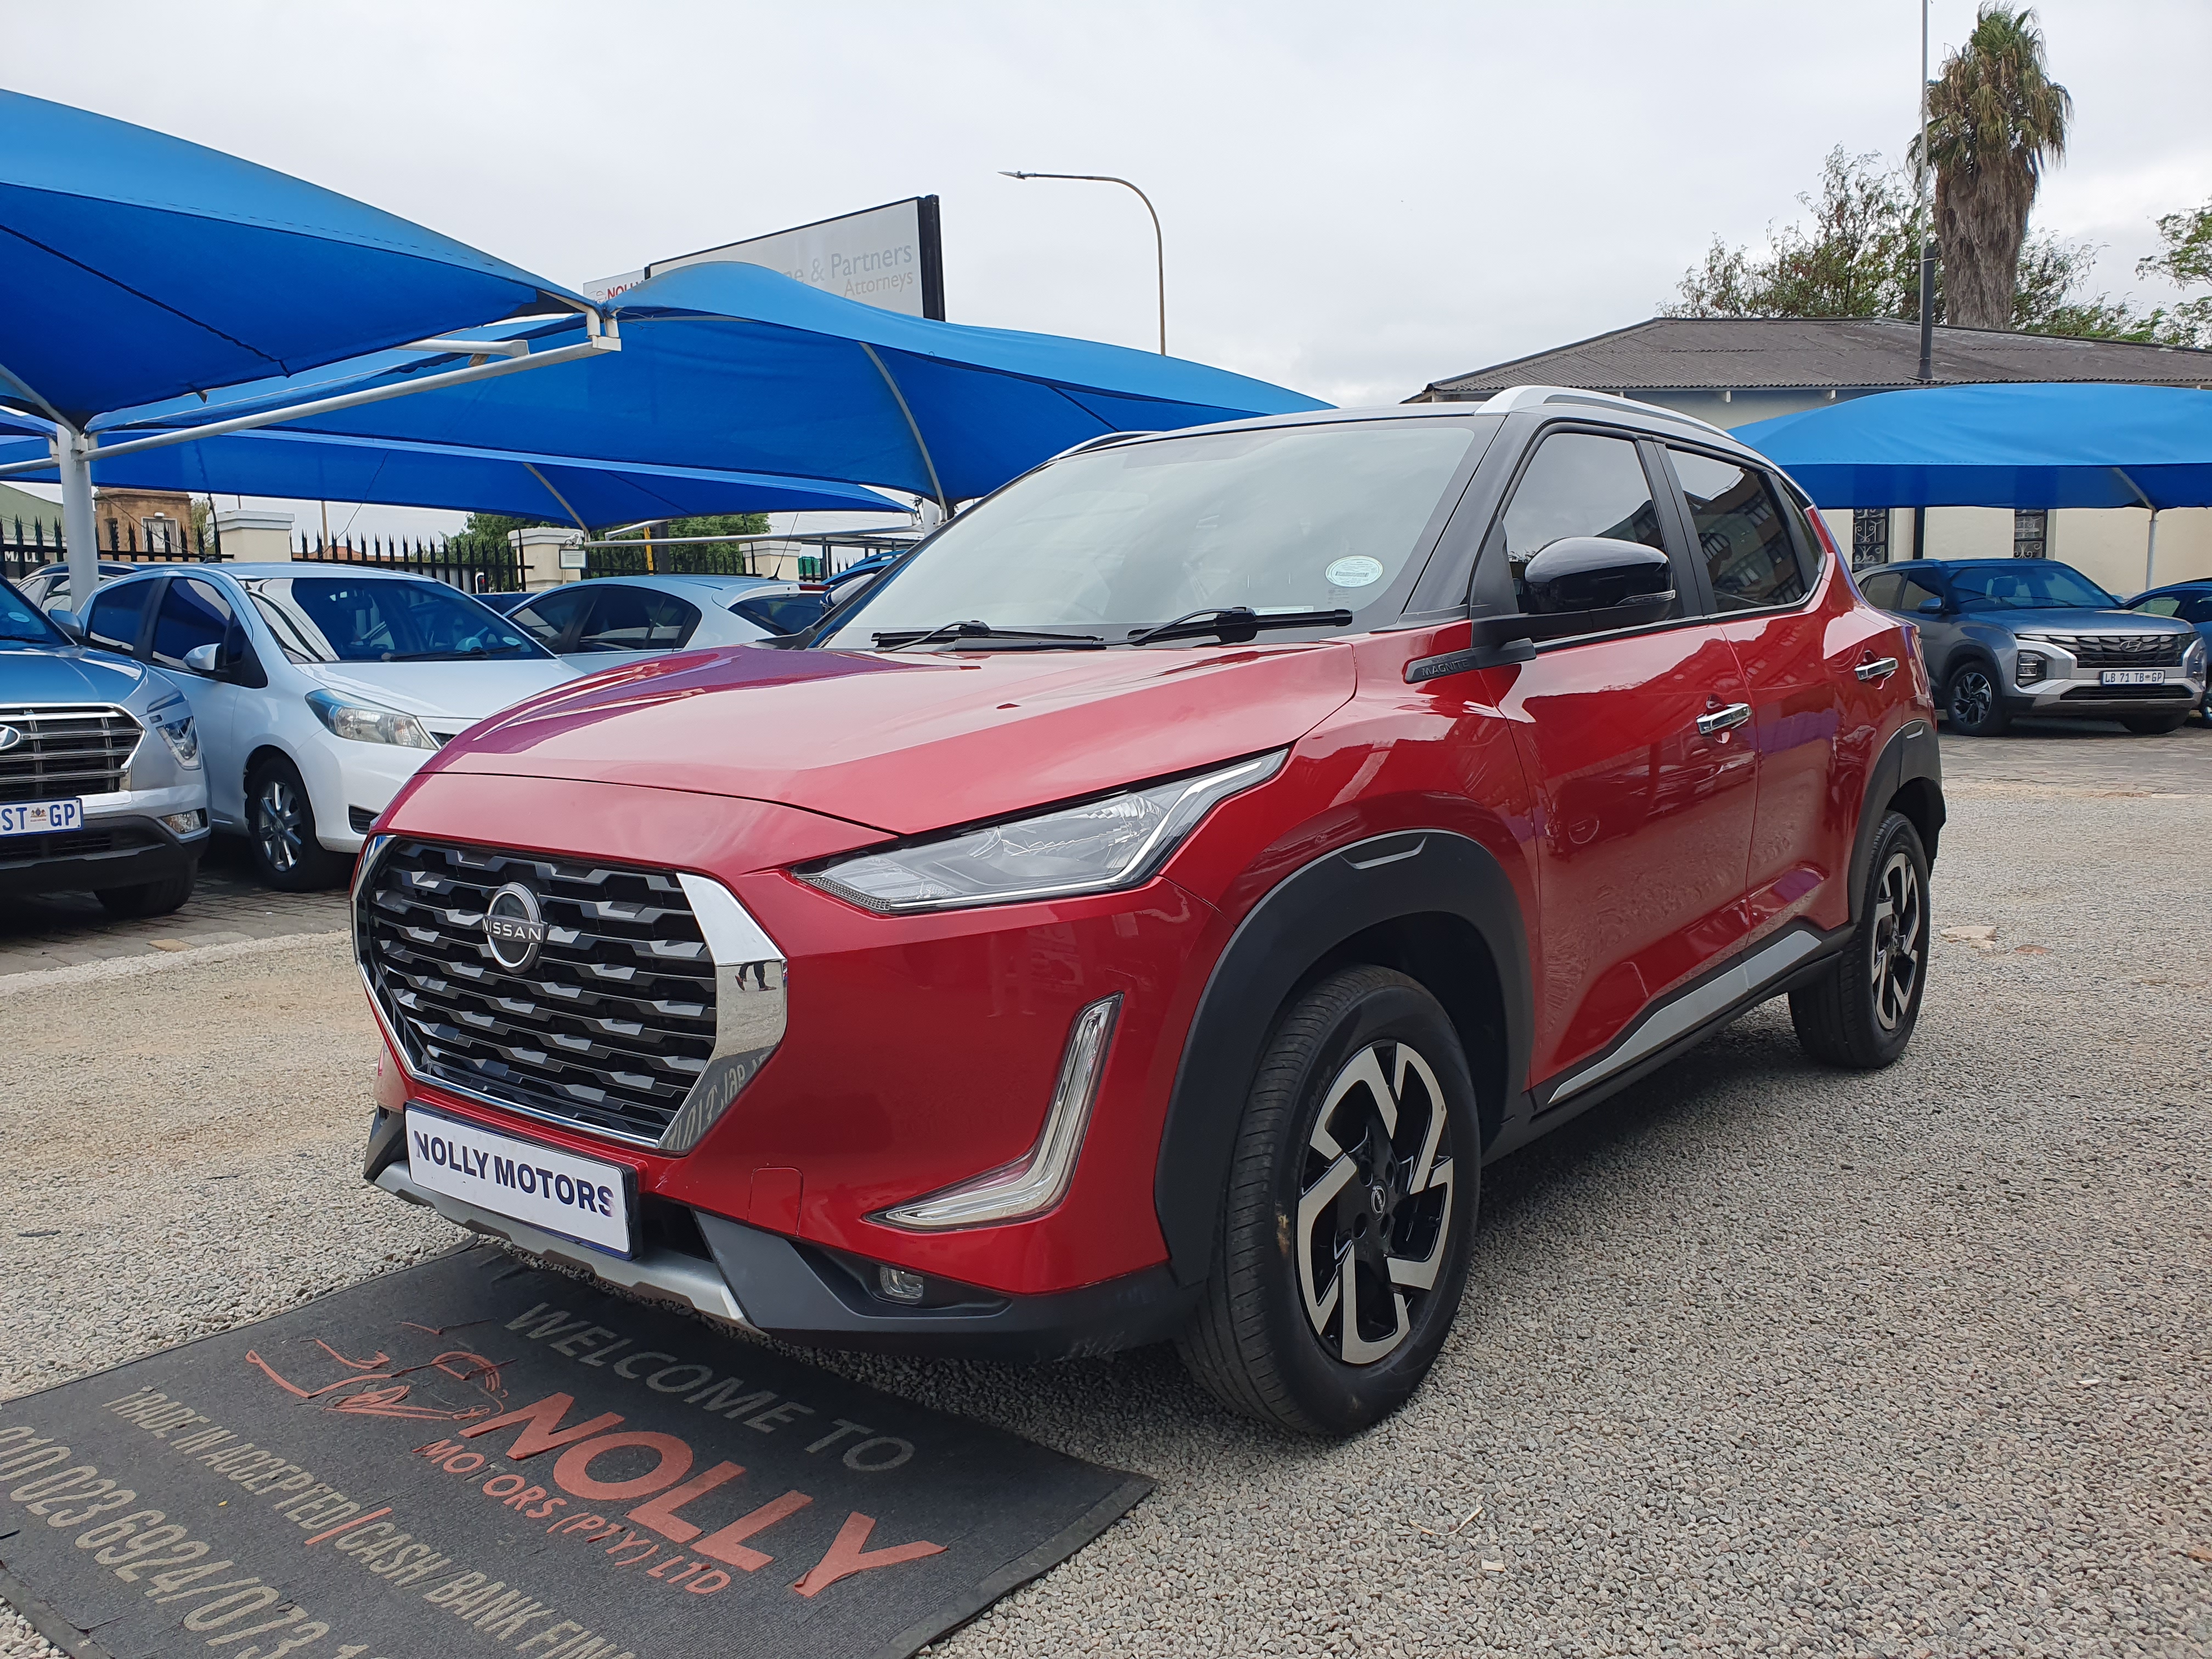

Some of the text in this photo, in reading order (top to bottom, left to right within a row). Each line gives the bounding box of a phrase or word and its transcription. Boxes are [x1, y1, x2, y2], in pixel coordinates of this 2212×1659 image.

[811, 258, 825, 283] &
[831, 245, 912, 279] Partners
[844, 272, 913, 297] Attorneys
[1421, 658, 1470, 677] MAGNITE
[2105, 672, 2162, 682] LB 71 TB GP
[1, 803, 75, 831] ST GP
[482, 918, 541, 940] NISSAN
[414, 1130, 614, 1218] NOLLY MOTORS
[504, 1302, 916, 1471] WELCOME TO
[102, 1385, 212, 1439] TRADE
[170, 1426, 239, 1455] IN
[10, 1465, 137, 1528] 023
[412, 1439, 731, 1594] MOTORS (PTY) LTD
[459, 1391, 949, 1598] NOLLY
